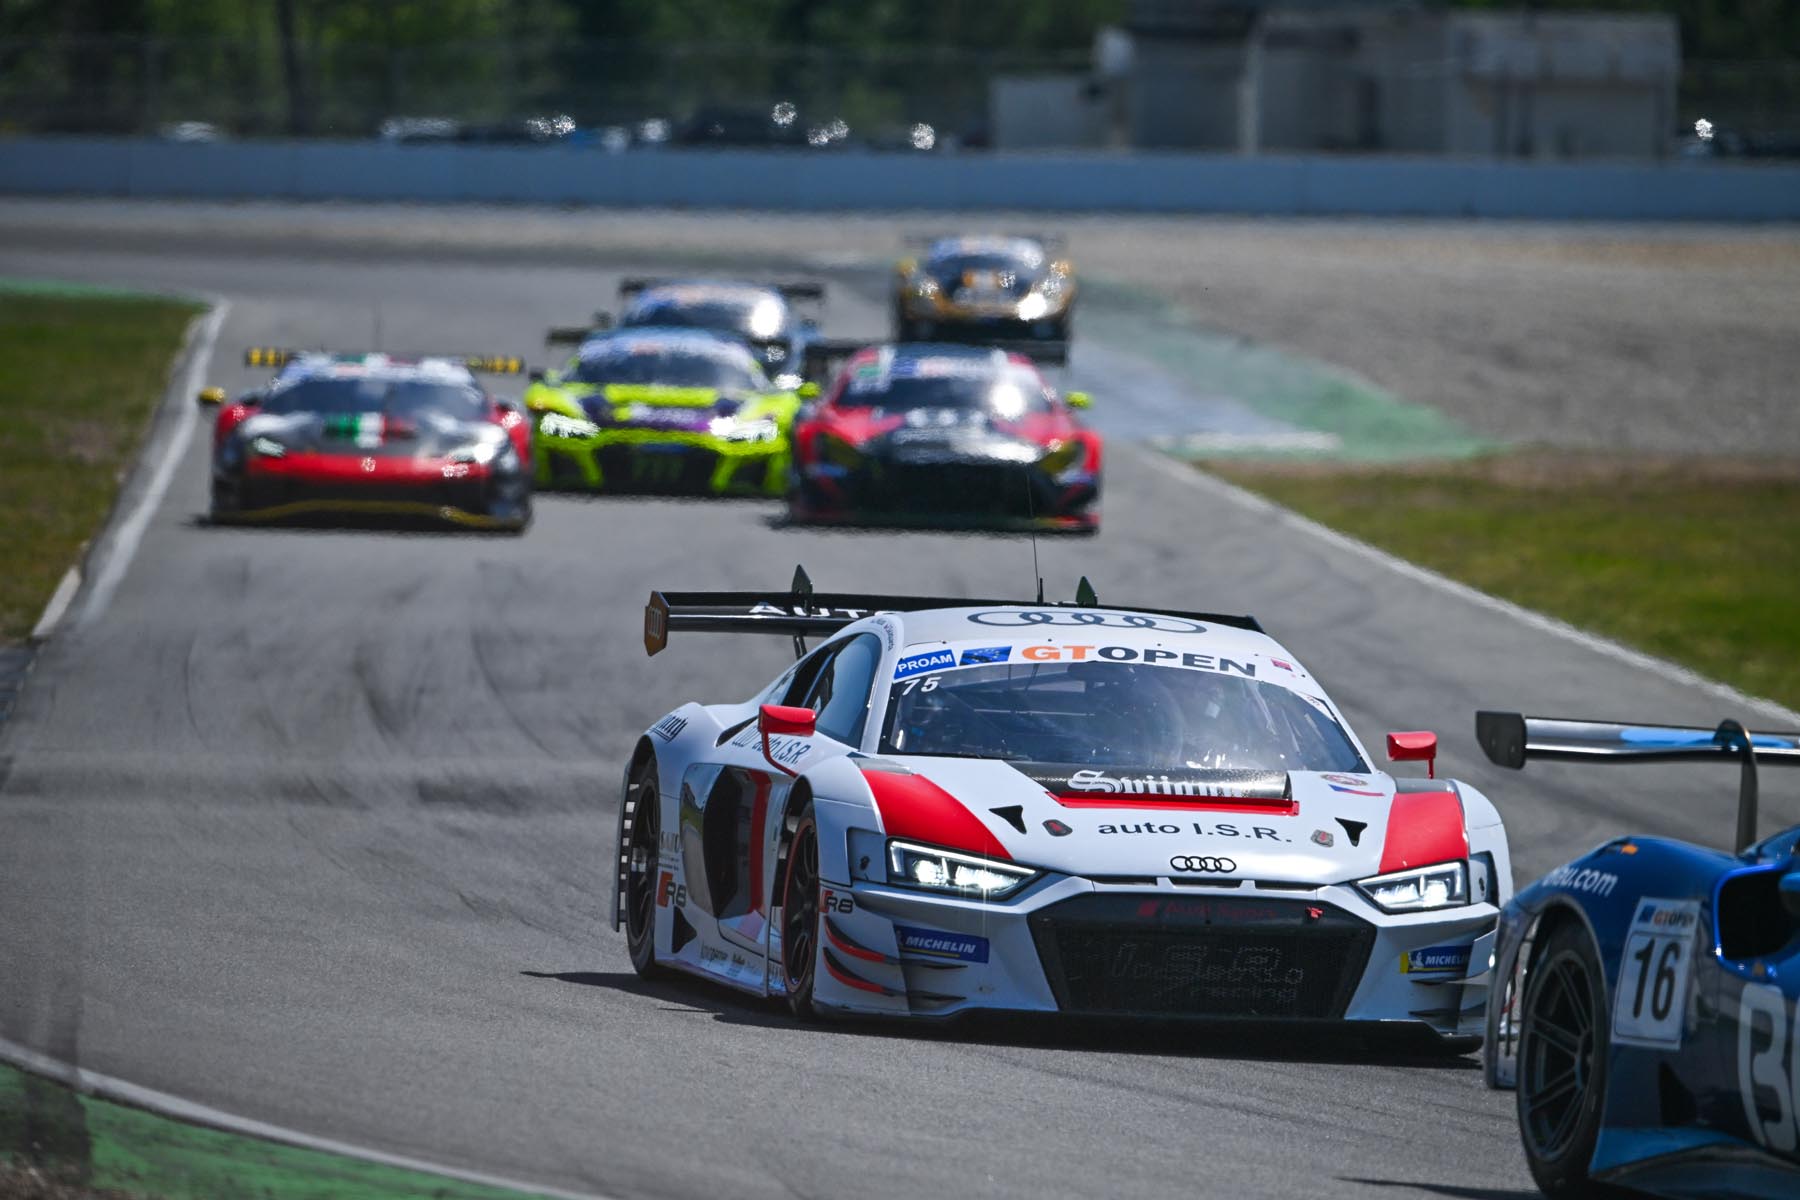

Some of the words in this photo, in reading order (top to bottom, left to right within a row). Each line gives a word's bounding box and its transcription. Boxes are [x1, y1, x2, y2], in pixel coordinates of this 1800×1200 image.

[897, 653, 953, 673] PROAM
[902, 676, 942, 696] 75
[1098, 822, 1181, 834] auto
[905, 935, 977, 954] MICHELIN
[1633, 938, 1682, 1021] 16
